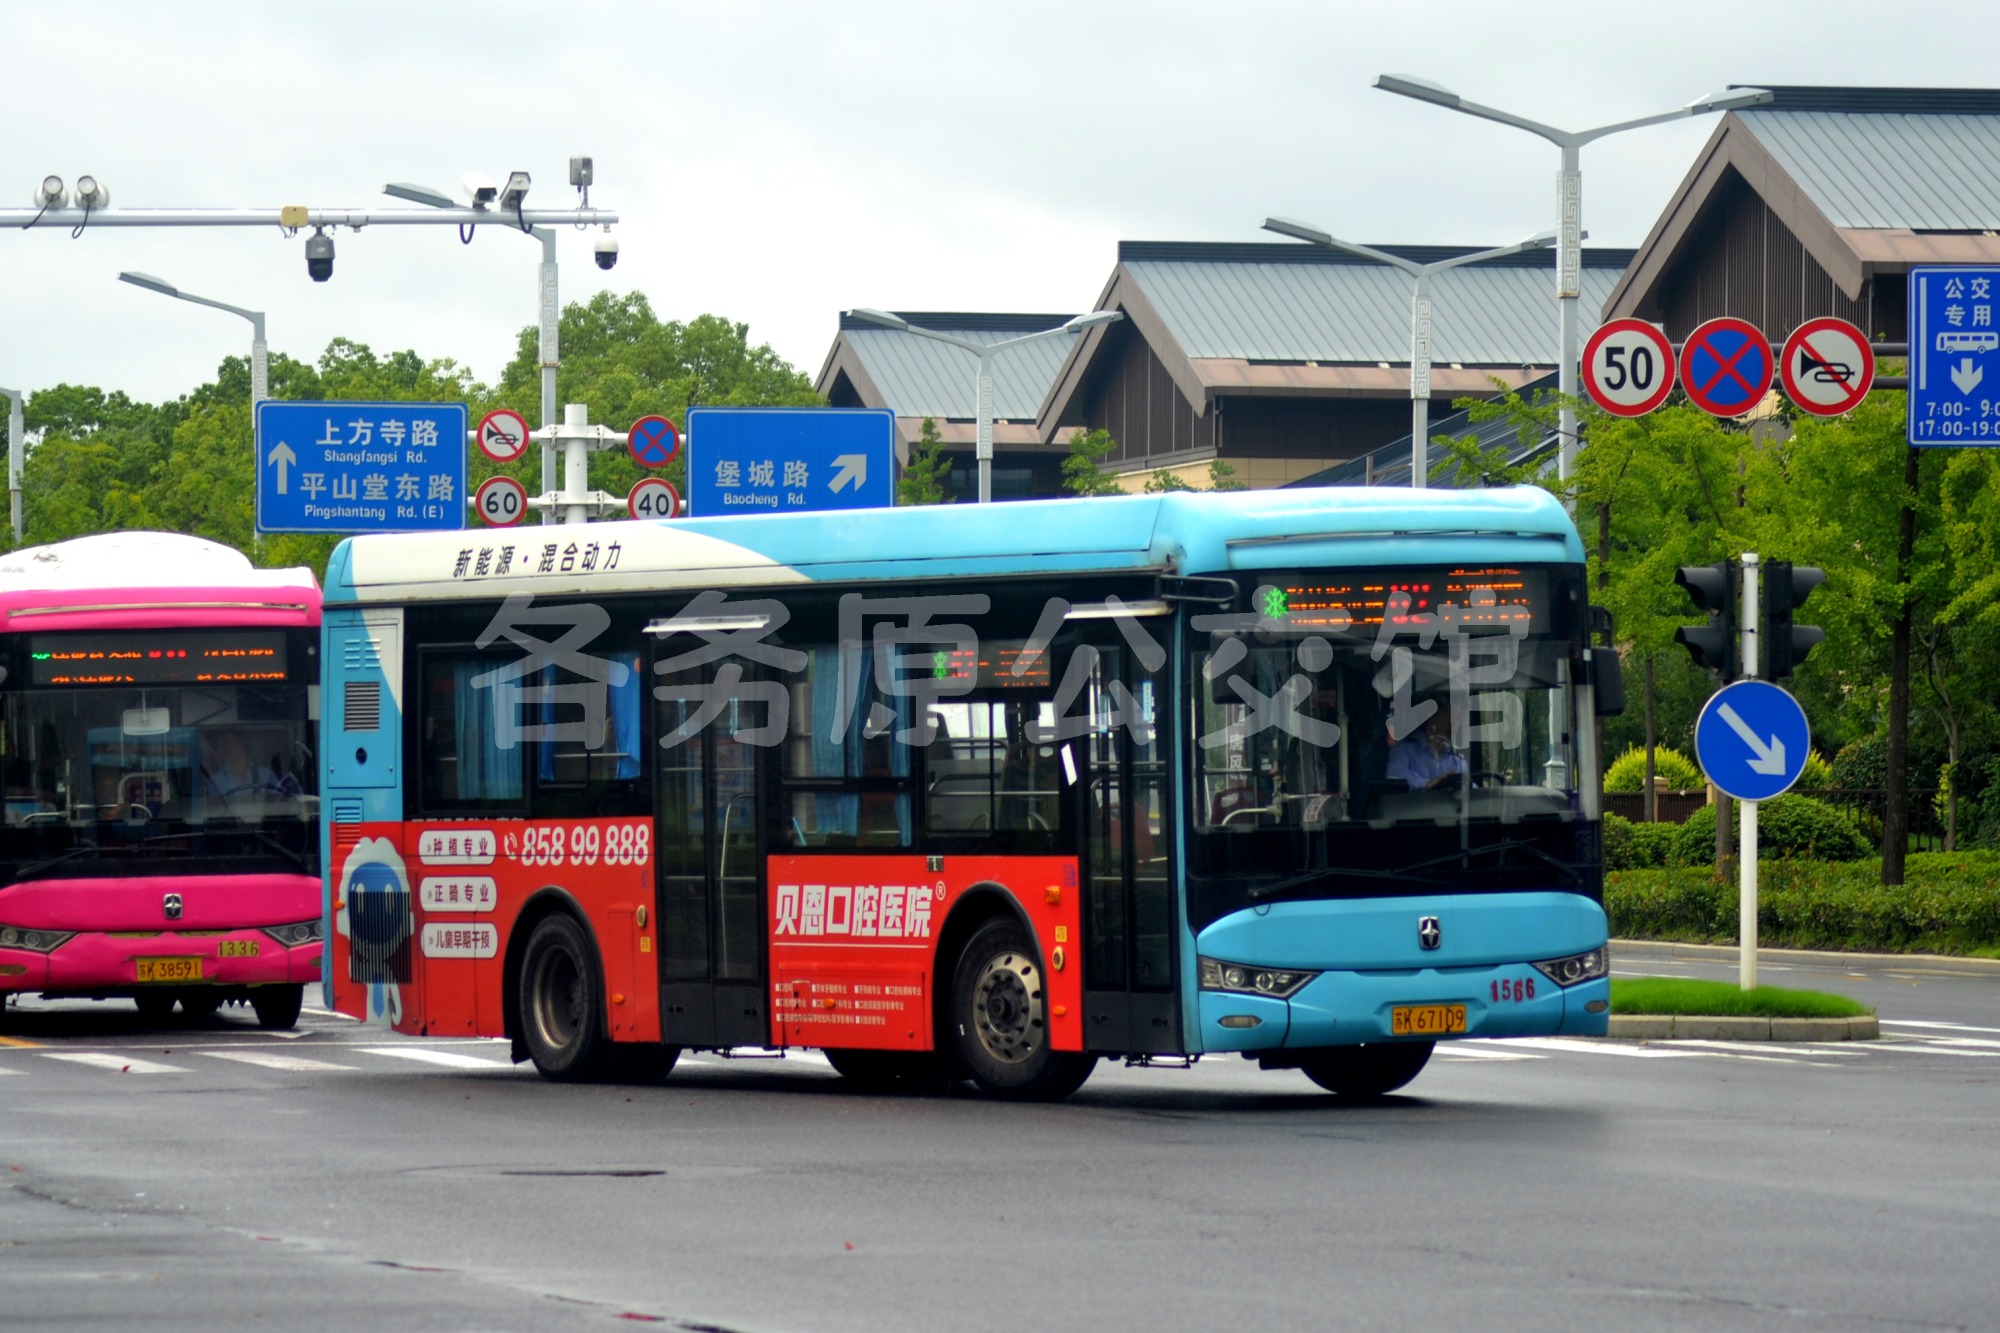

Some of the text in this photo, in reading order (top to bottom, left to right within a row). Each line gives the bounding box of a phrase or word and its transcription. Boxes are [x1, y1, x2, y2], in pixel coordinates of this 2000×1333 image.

[1943, 277, 1991, 299] 公交
[1944, 304, 1991, 327] 专用
[1604, 346, 1654, 391] 50
[316, 418, 439, 447] 上方寺路
[324, 450, 427, 466] Shangfangsi Rd.
[714, 459, 810, 488] 堡城路
[300, 472, 455, 502] 平山堂东路
[486, 491, 518, 514] 60
[638, 492, 670, 516] 40
[723, 492, 807, 508] Baocheng Rd.
[304, 504, 444, 521] Pingshantang Rd. (E)
[433, 836, 489, 857] 种植专业
[520, 824, 649, 866] 858 99 888
[217, 941, 259, 957] 1336
[435, 930, 490, 950] 儿童早期干预
[1490, 977, 1535, 1003] 1566
